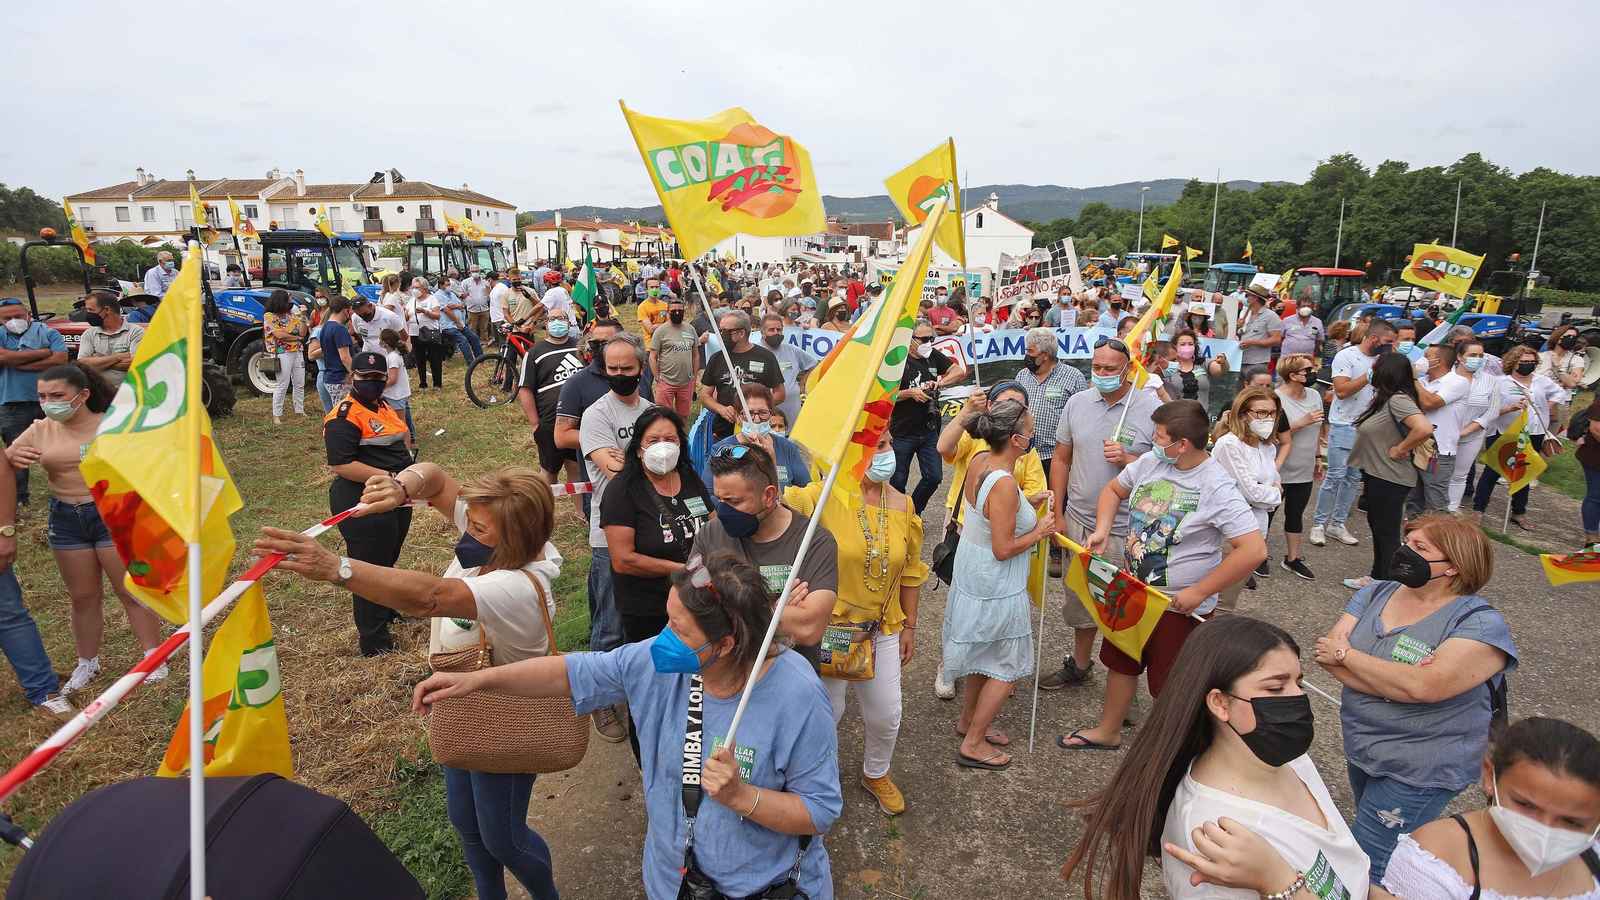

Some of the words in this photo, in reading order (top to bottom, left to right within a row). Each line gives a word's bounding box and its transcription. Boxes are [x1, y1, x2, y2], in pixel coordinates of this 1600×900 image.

[655, 142, 781, 187] COAG
[881, 275, 893, 283] NO
[951, 280, 965, 288] NO
[1035, 280, 1050, 293] NO
[554, 367, 585, 382] adid
[830, 630, 851, 640] DEFIENDO
[688, 673, 703, 712] LOLA
[687, 715, 702, 725] Y
[714, 741, 754, 757] CALLAR
[682, 730, 702, 785] BIMBA
[1306, 854, 1326, 886] ASTELLAR
